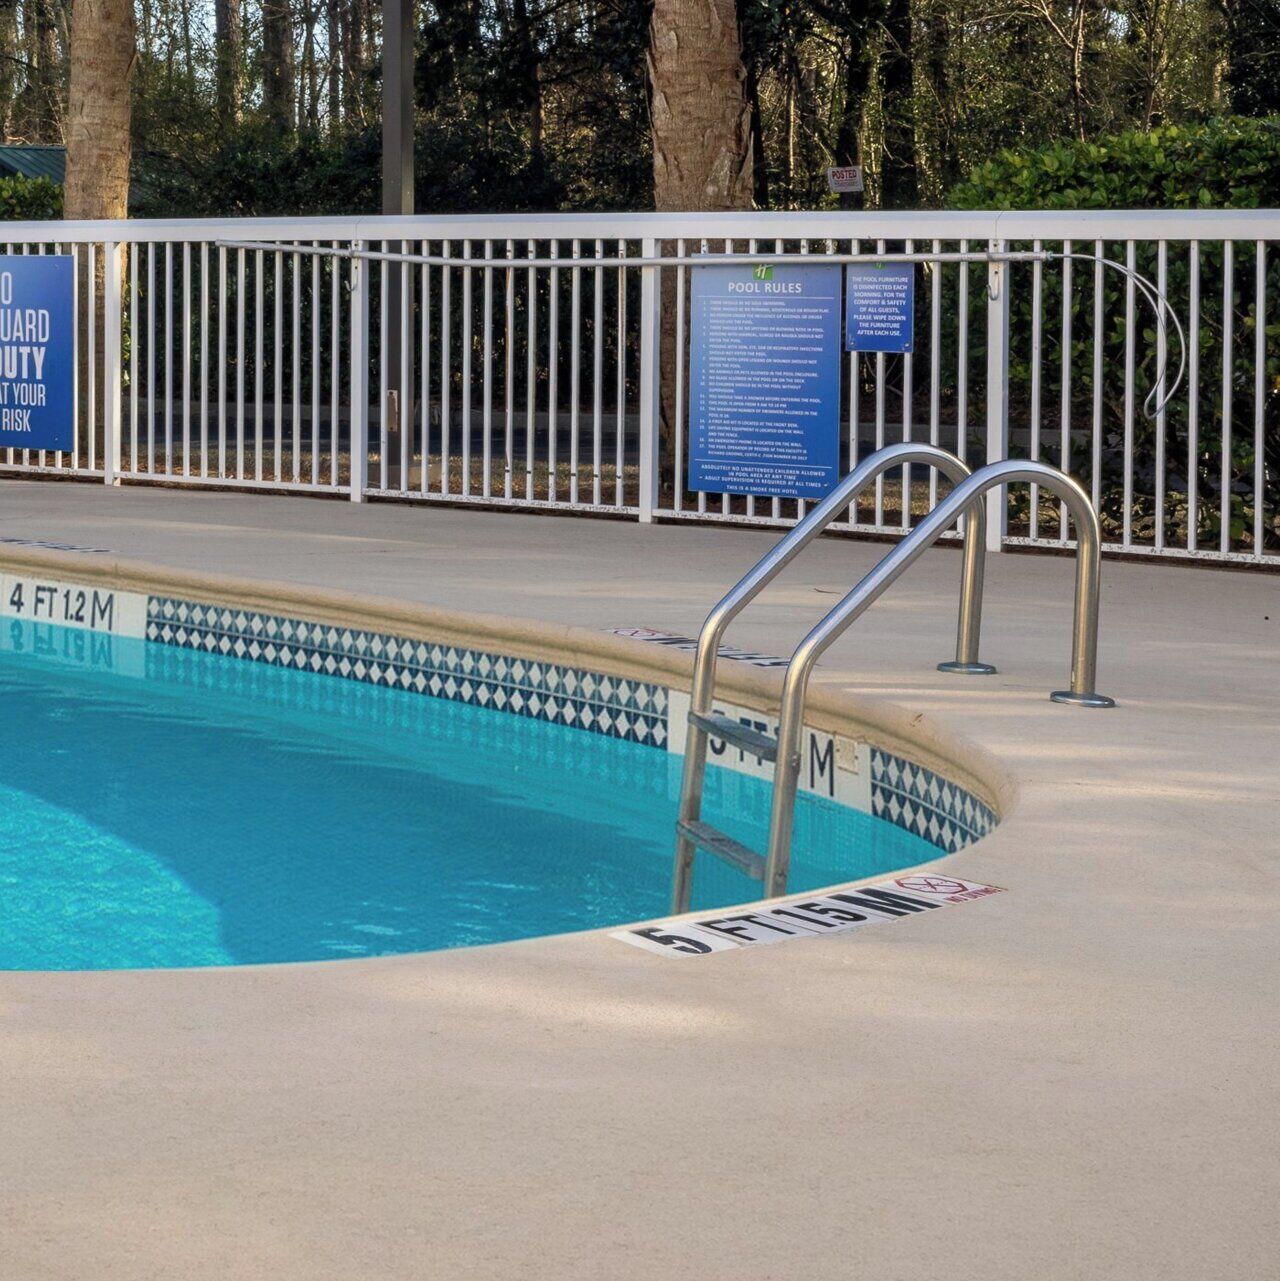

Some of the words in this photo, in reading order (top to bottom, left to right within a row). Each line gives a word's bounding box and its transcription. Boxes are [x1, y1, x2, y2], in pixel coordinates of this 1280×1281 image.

[832, 170, 856, 179] POSTED
[728, 283, 760, 292] POOL
[765, 283, 802, 293] RULES
[13, 383, 45, 406] YOUR
[3, 408, 31, 432] RISK
[722, 476, 753, 484] SUPERVISION
[762, 478, 786, 486] REQUIRED
[741, 466, 773, 474] UNATTENDED
[10, 583, 24, 612] 4
[34, 586, 57, 617] FT
[64, 590, 86, 622] 1.2
[91, 590, 113, 631] M
[810, 733, 834, 797] M
[629, 926, 712, 954] 5
[695, 914, 795, 941] FT
[770, 902, 868, 927] 1.5
[823, 887, 944, 917] M
